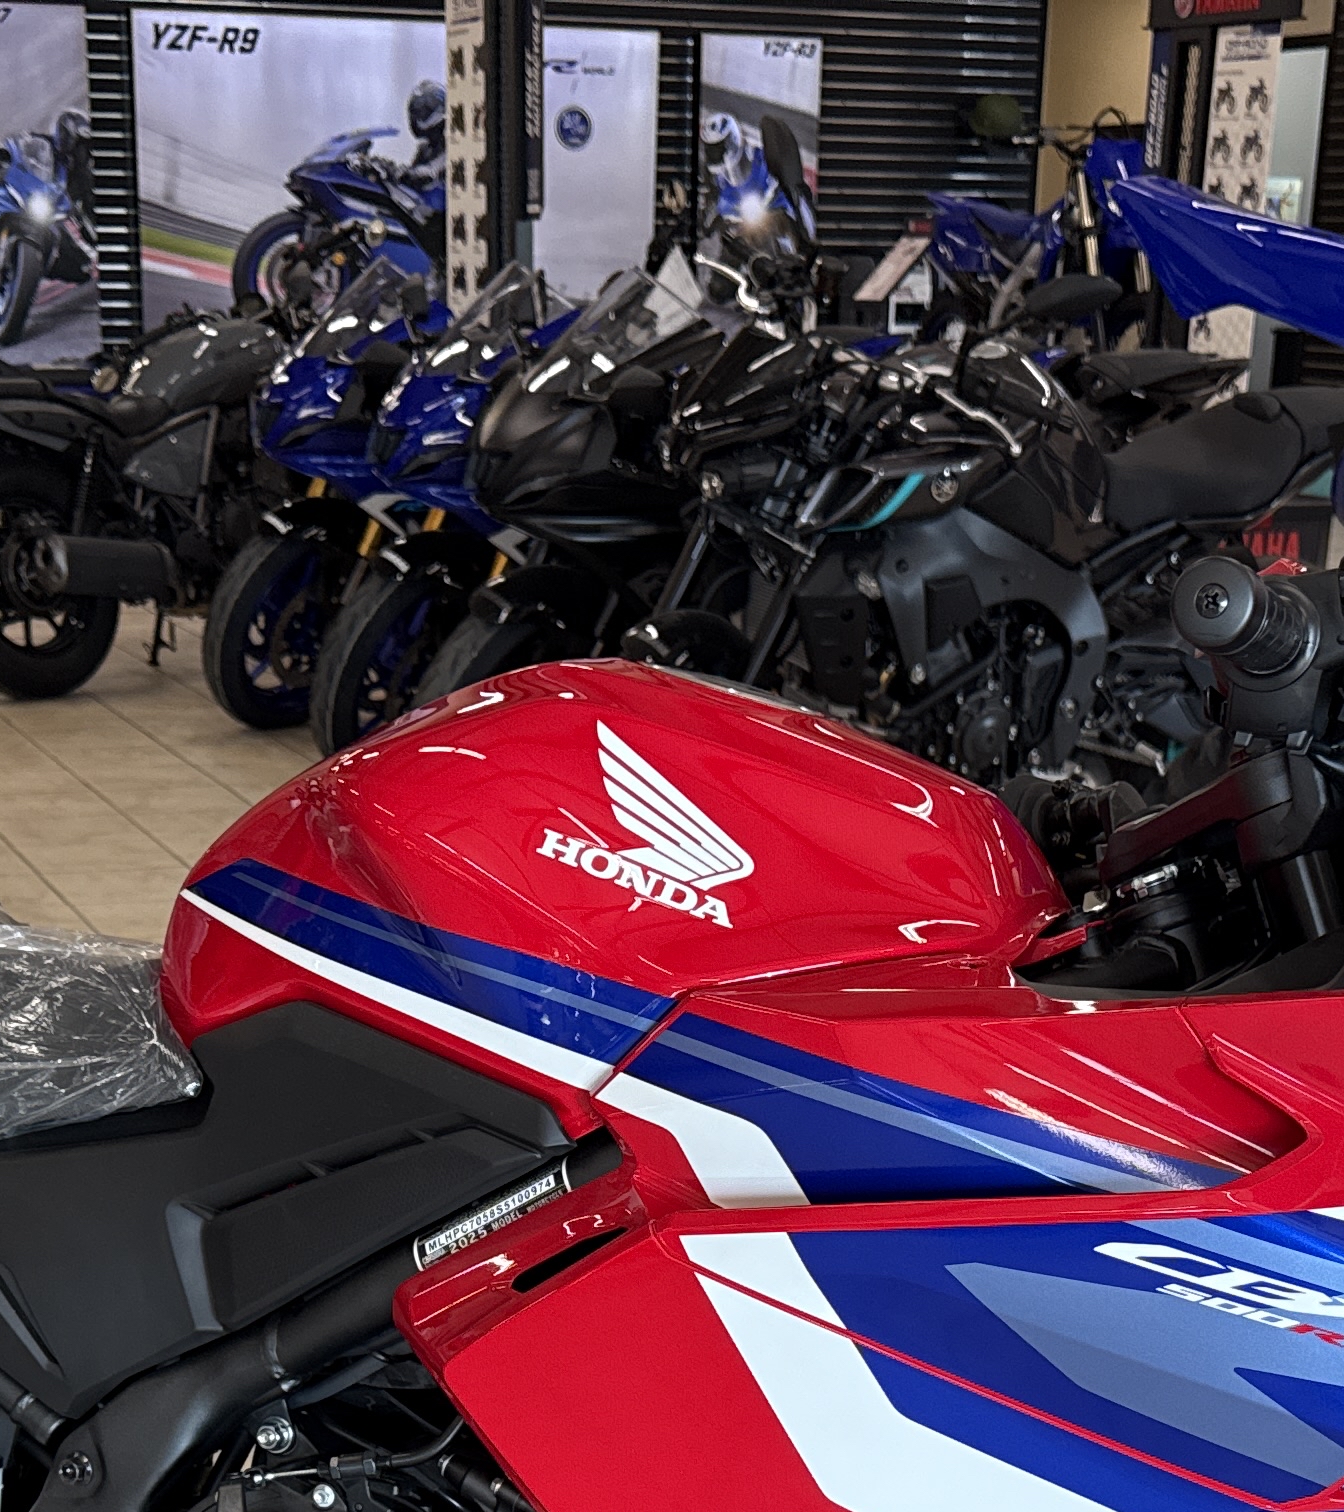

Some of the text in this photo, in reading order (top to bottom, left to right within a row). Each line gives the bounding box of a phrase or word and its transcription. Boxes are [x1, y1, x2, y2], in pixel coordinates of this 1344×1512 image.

[152, 23, 261, 54] YZF-R9
[536, 828, 734, 929] HONDA
[448, 1226, 488, 1255] 2025
[490, 1209, 524, 1232] MODEL
